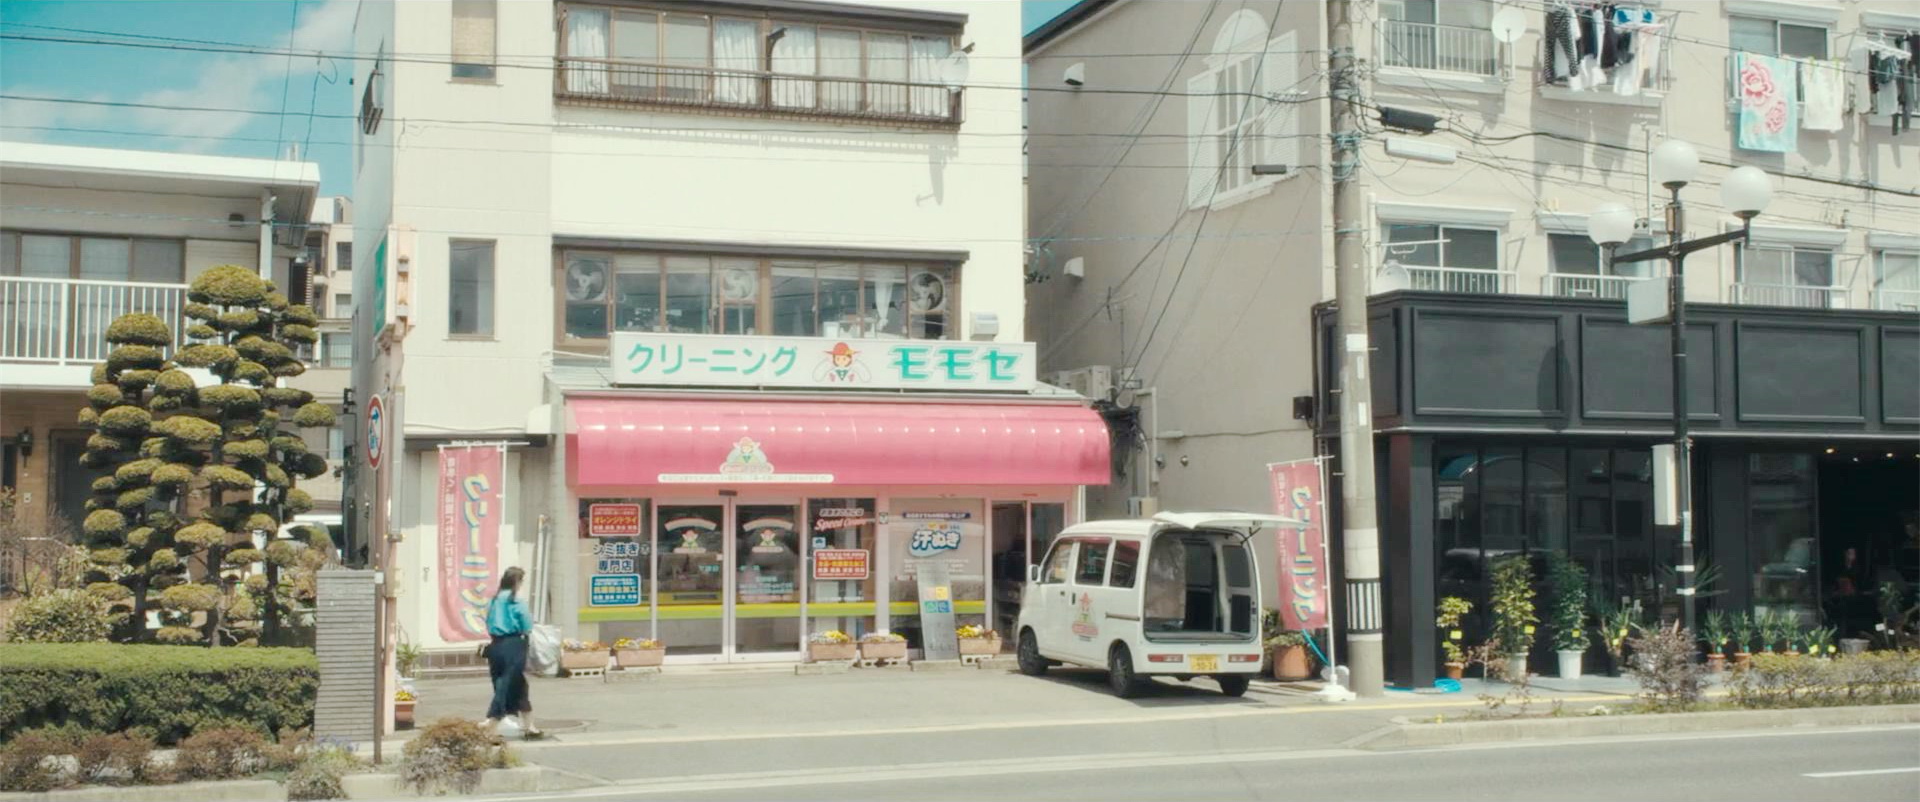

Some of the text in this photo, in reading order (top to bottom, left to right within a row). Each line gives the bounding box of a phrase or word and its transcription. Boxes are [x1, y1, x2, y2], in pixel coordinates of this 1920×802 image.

[627, 343, 1021, 382] クリーニング モモセ
